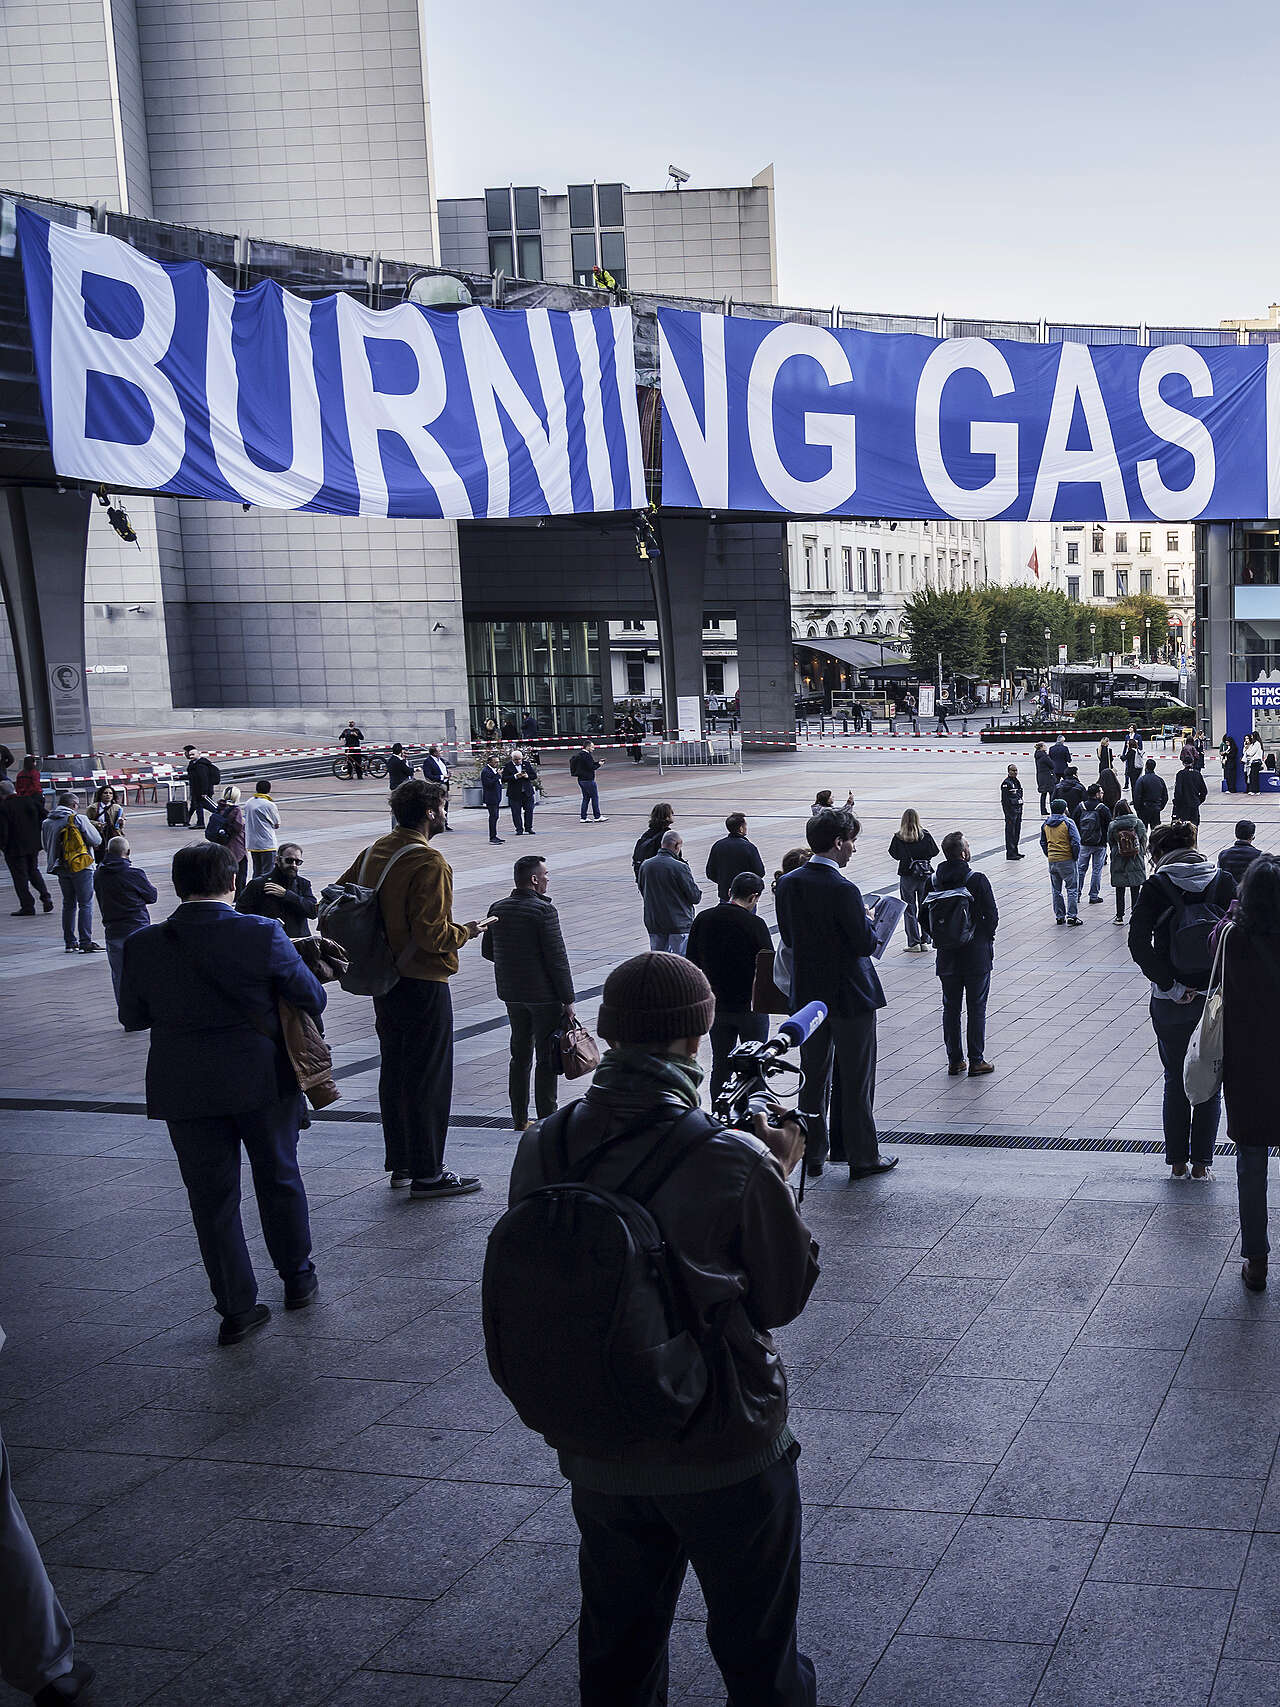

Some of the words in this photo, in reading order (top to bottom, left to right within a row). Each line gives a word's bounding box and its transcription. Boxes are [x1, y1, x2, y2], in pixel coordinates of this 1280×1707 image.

[48, 222, 857, 520] BURNING
[914, 336, 1217, 521] GAS
[1251, 696, 1264, 705] IN
